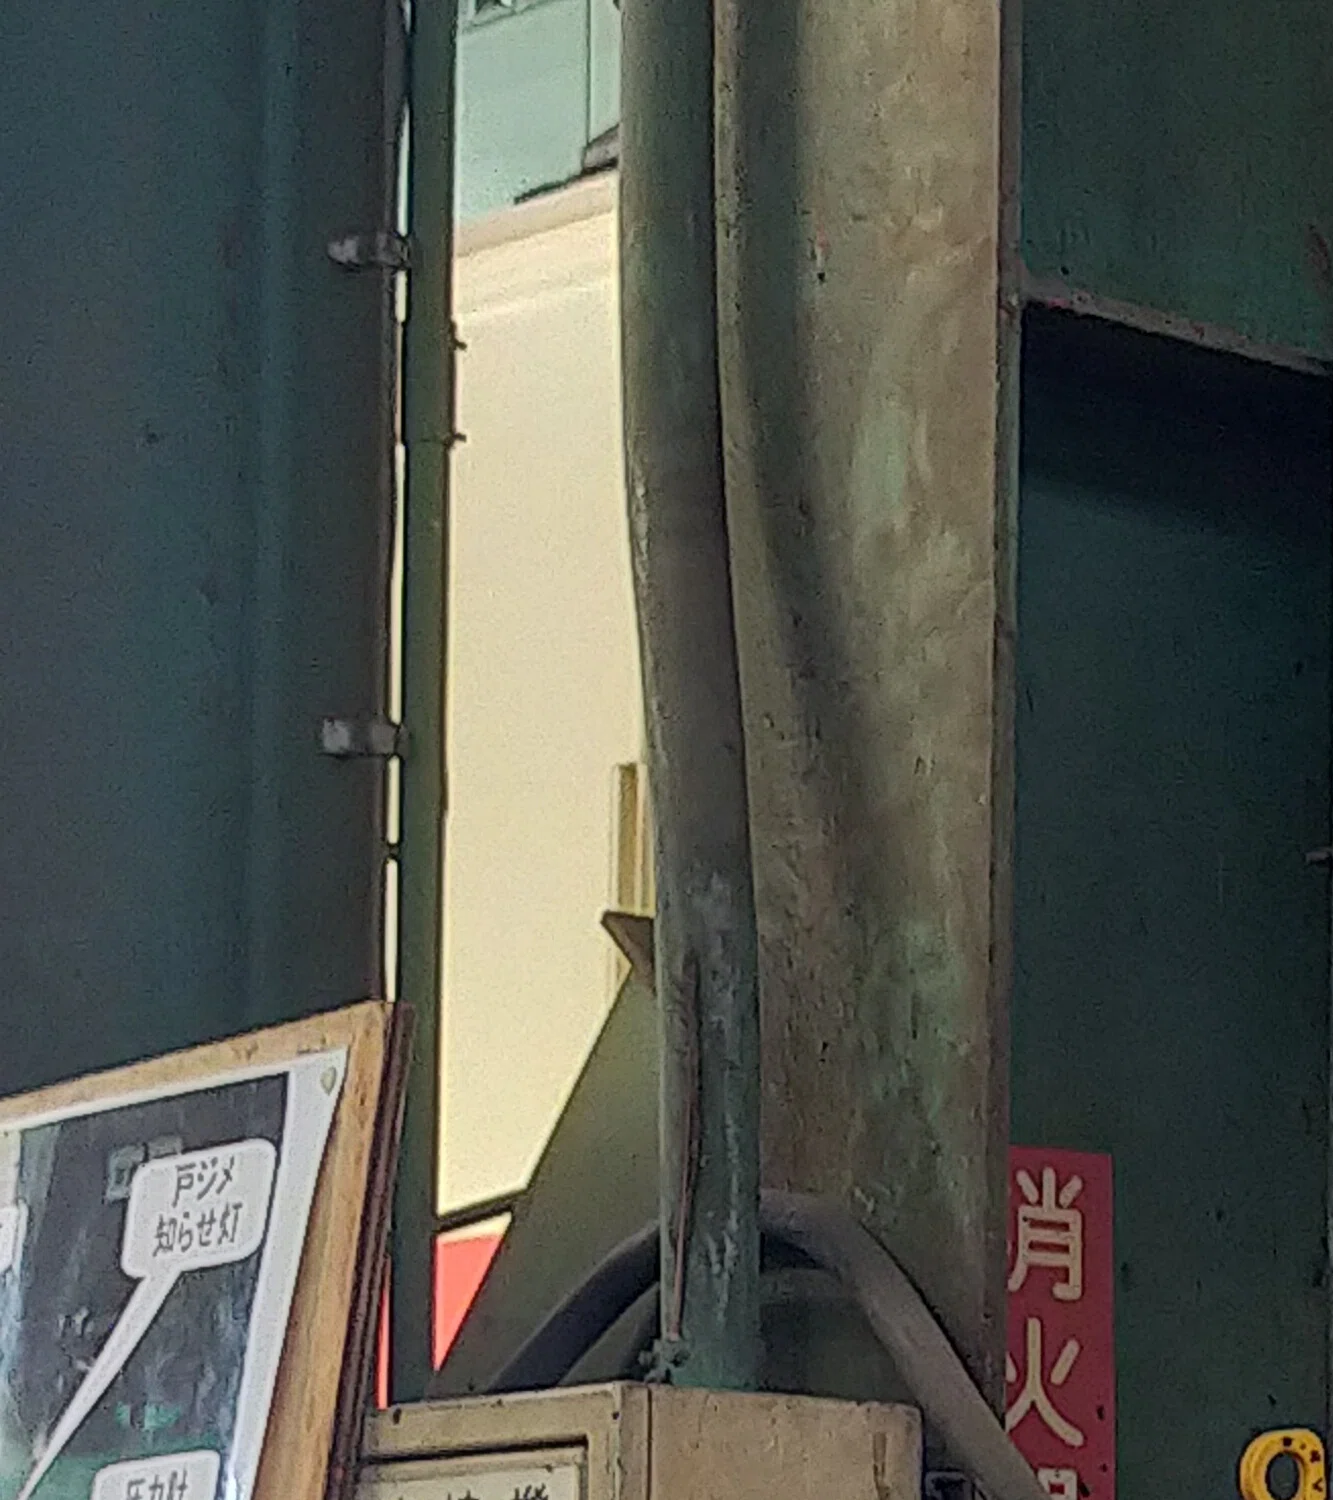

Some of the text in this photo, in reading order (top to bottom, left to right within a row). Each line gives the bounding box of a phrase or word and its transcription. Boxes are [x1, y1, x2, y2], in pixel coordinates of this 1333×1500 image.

[171, 1156, 235, 1208] 戸ジメ
[153, 1202, 244, 1257] 知らせ灯
